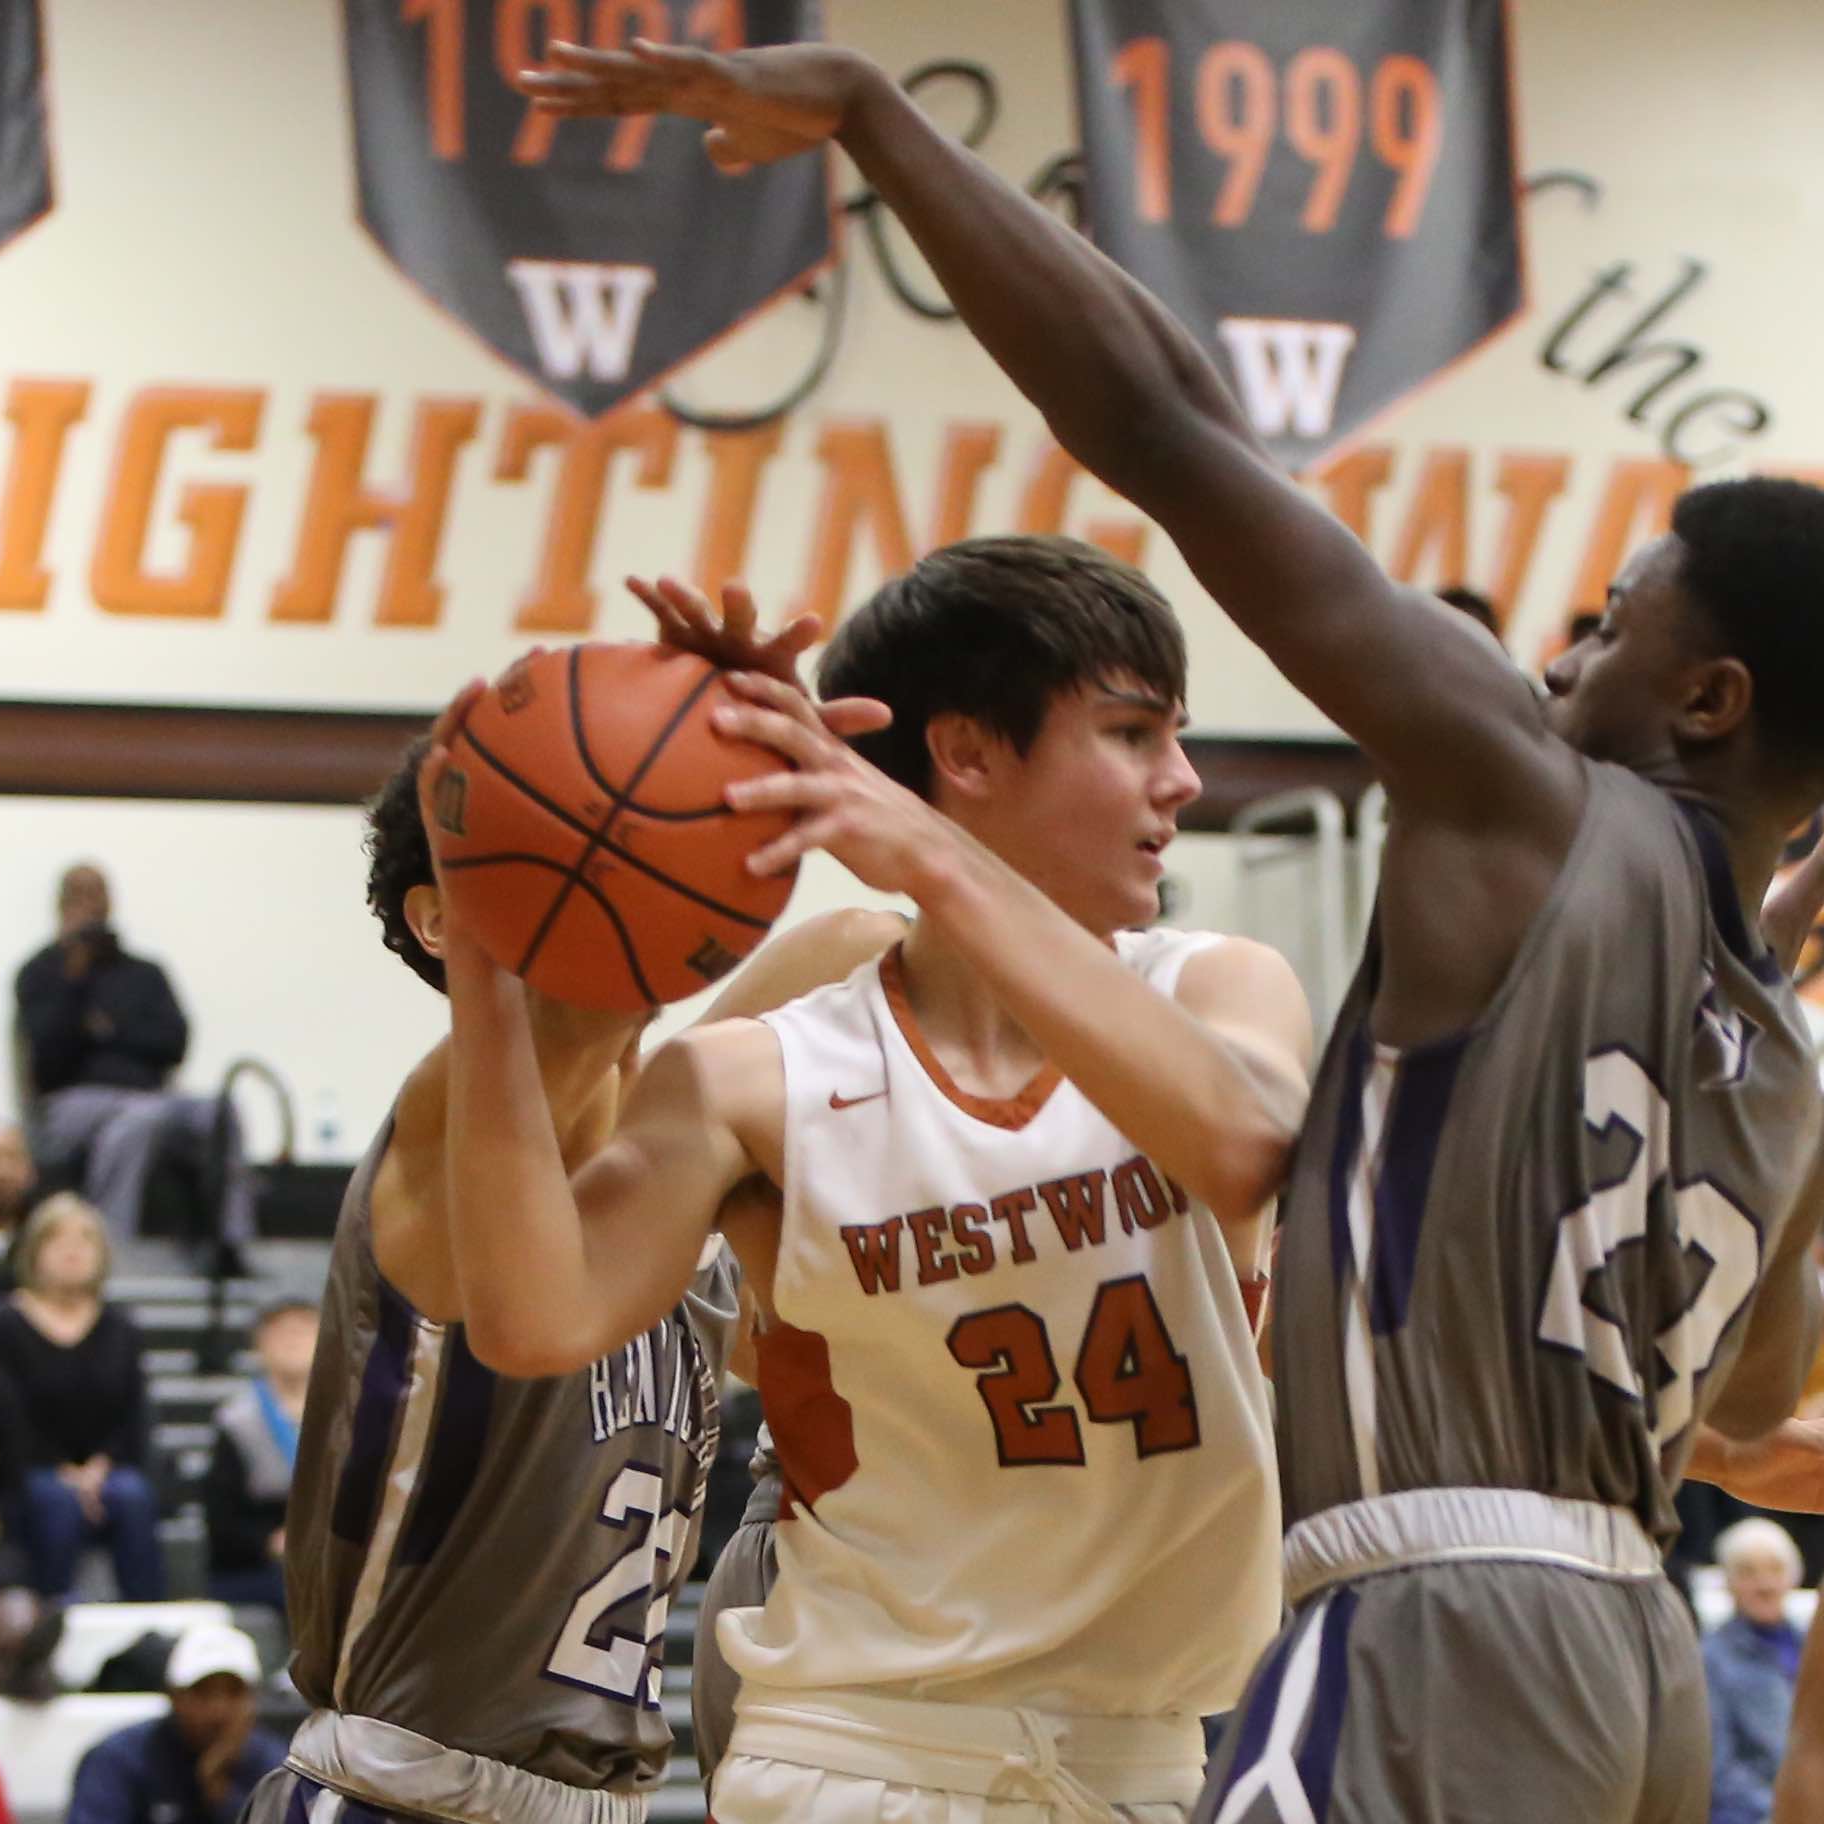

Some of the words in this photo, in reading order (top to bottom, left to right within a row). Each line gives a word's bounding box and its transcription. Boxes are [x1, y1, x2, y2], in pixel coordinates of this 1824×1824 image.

[1109, 38, 1440, 240] 1999
[507, 259, 656, 383] W
[1220, 318, 1355, 437] W
[1541, 255, 1769, 467] the
[945, 1273, 1202, 1469] 24
